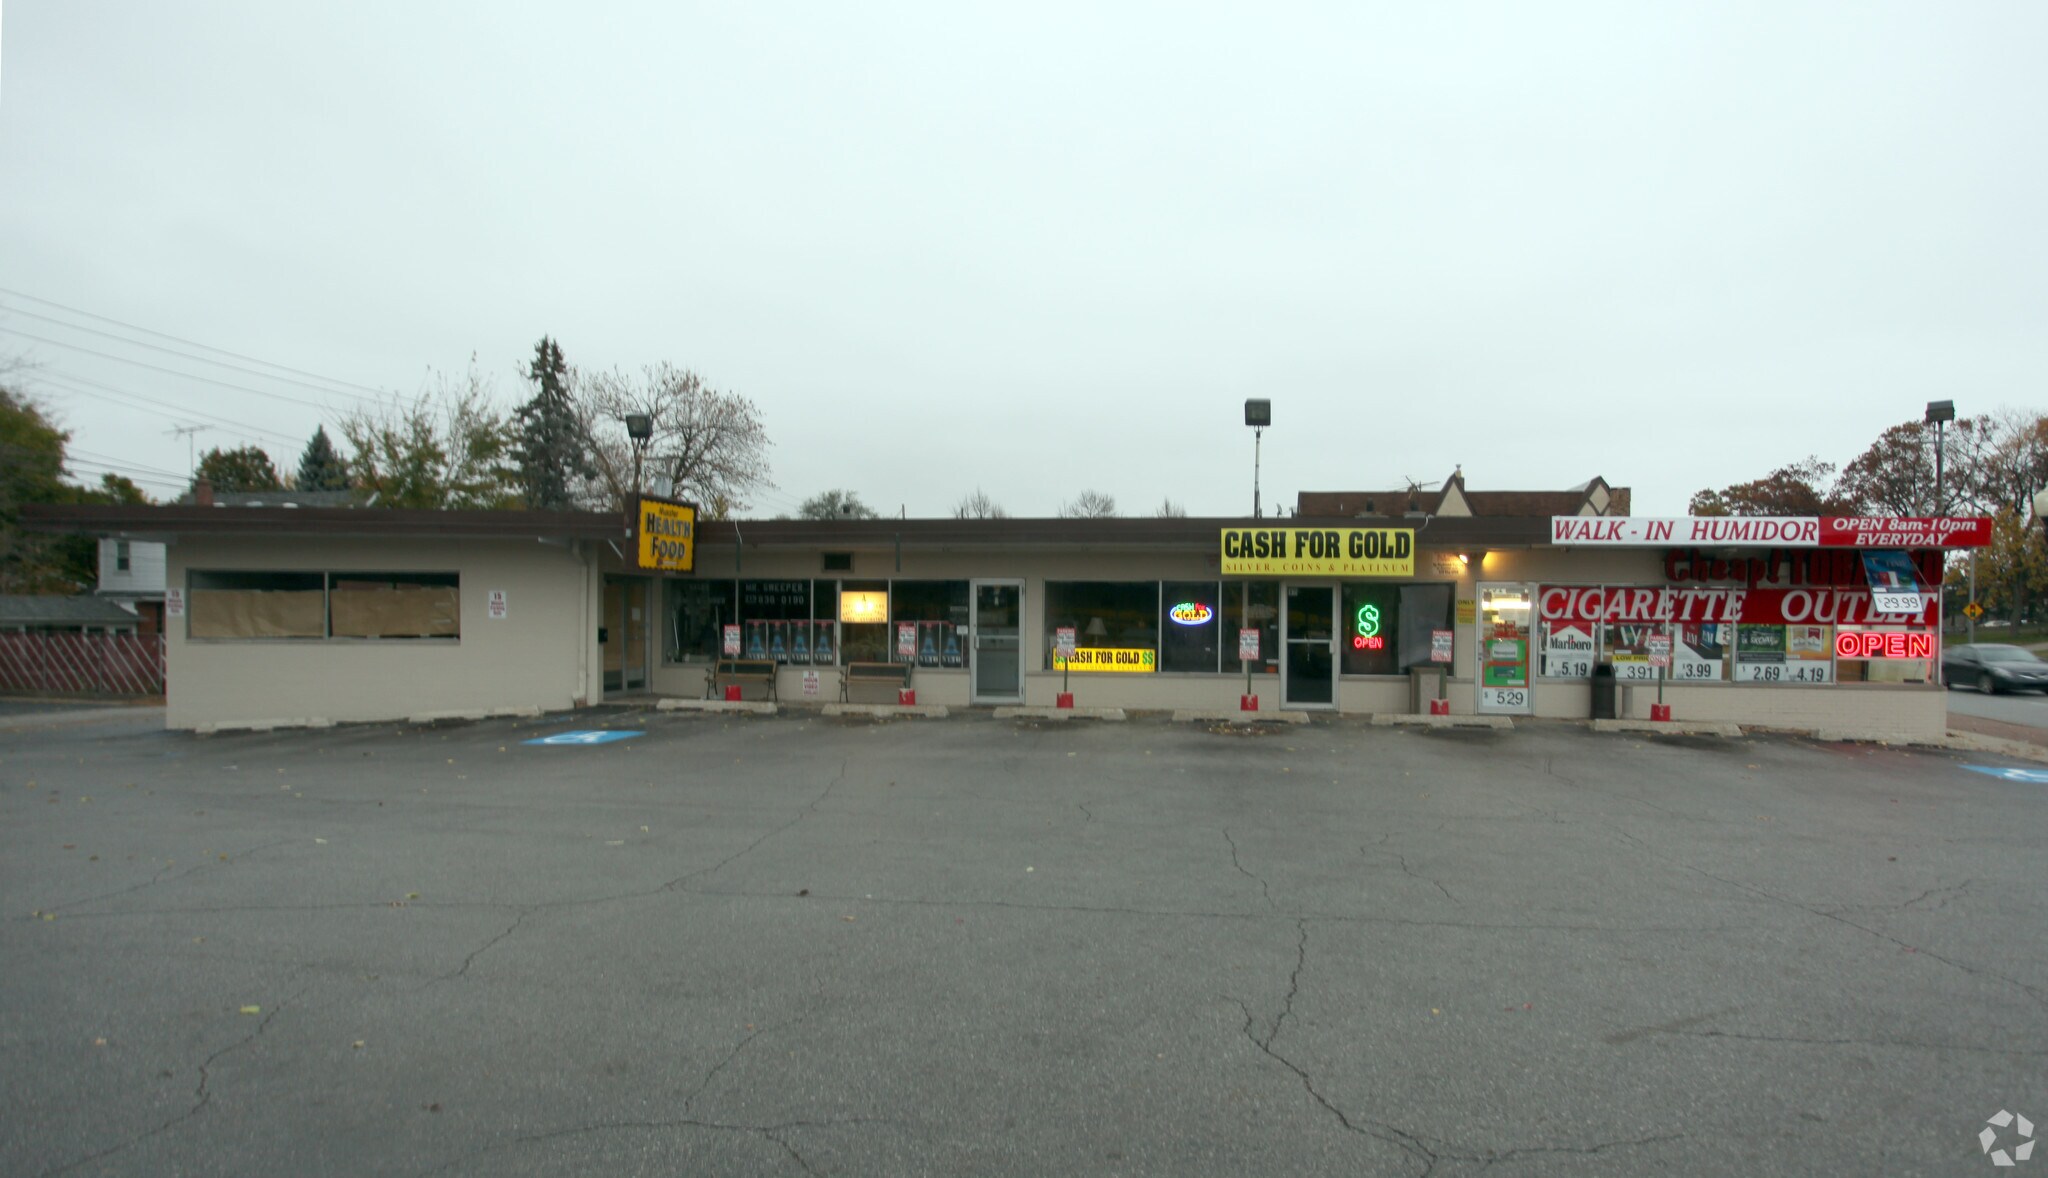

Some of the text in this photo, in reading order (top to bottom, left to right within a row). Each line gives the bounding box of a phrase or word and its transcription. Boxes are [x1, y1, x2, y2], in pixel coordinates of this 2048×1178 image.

[646, 512, 691, 539] HEALTH
[1555, 520, 1626, 541] WALK
[1644, 520, 1675, 541] IN
[1690, 520, 1818, 541] HUMIDOR
[1833, 518, 1977, 533] OPEN 8am-10pm
[1224, 530, 1411, 559] CASH FOR GOLD
[1855, 532, 1949, 546] EVERYDAY
[651, 536, 686, 560] FOOD
[1226, 563, 1409, 572] SILVER, COINS & PLATINUM
[1664, 547, 1783, 589] Cheap!
[1176, 602, 1195, 611] CASH
[1540, 588, 1747, 622] CIGARETTE
[1173, 609, 1209, 621] GOLD
[1354, 637, 1382, 649] OPEN
[1549, 634, 1592, 651] Marlboro
[1836, 632, 1934, 658] OPEN
[1096, 651, 1113, 663] FOR
[1116, 651, 1140, 664] GOLD
[1562, 661, 1588, 676] 5.19
[1753, 666, 1780, 681] 2.69
[1796, 667, 1824, 682] 4.19
